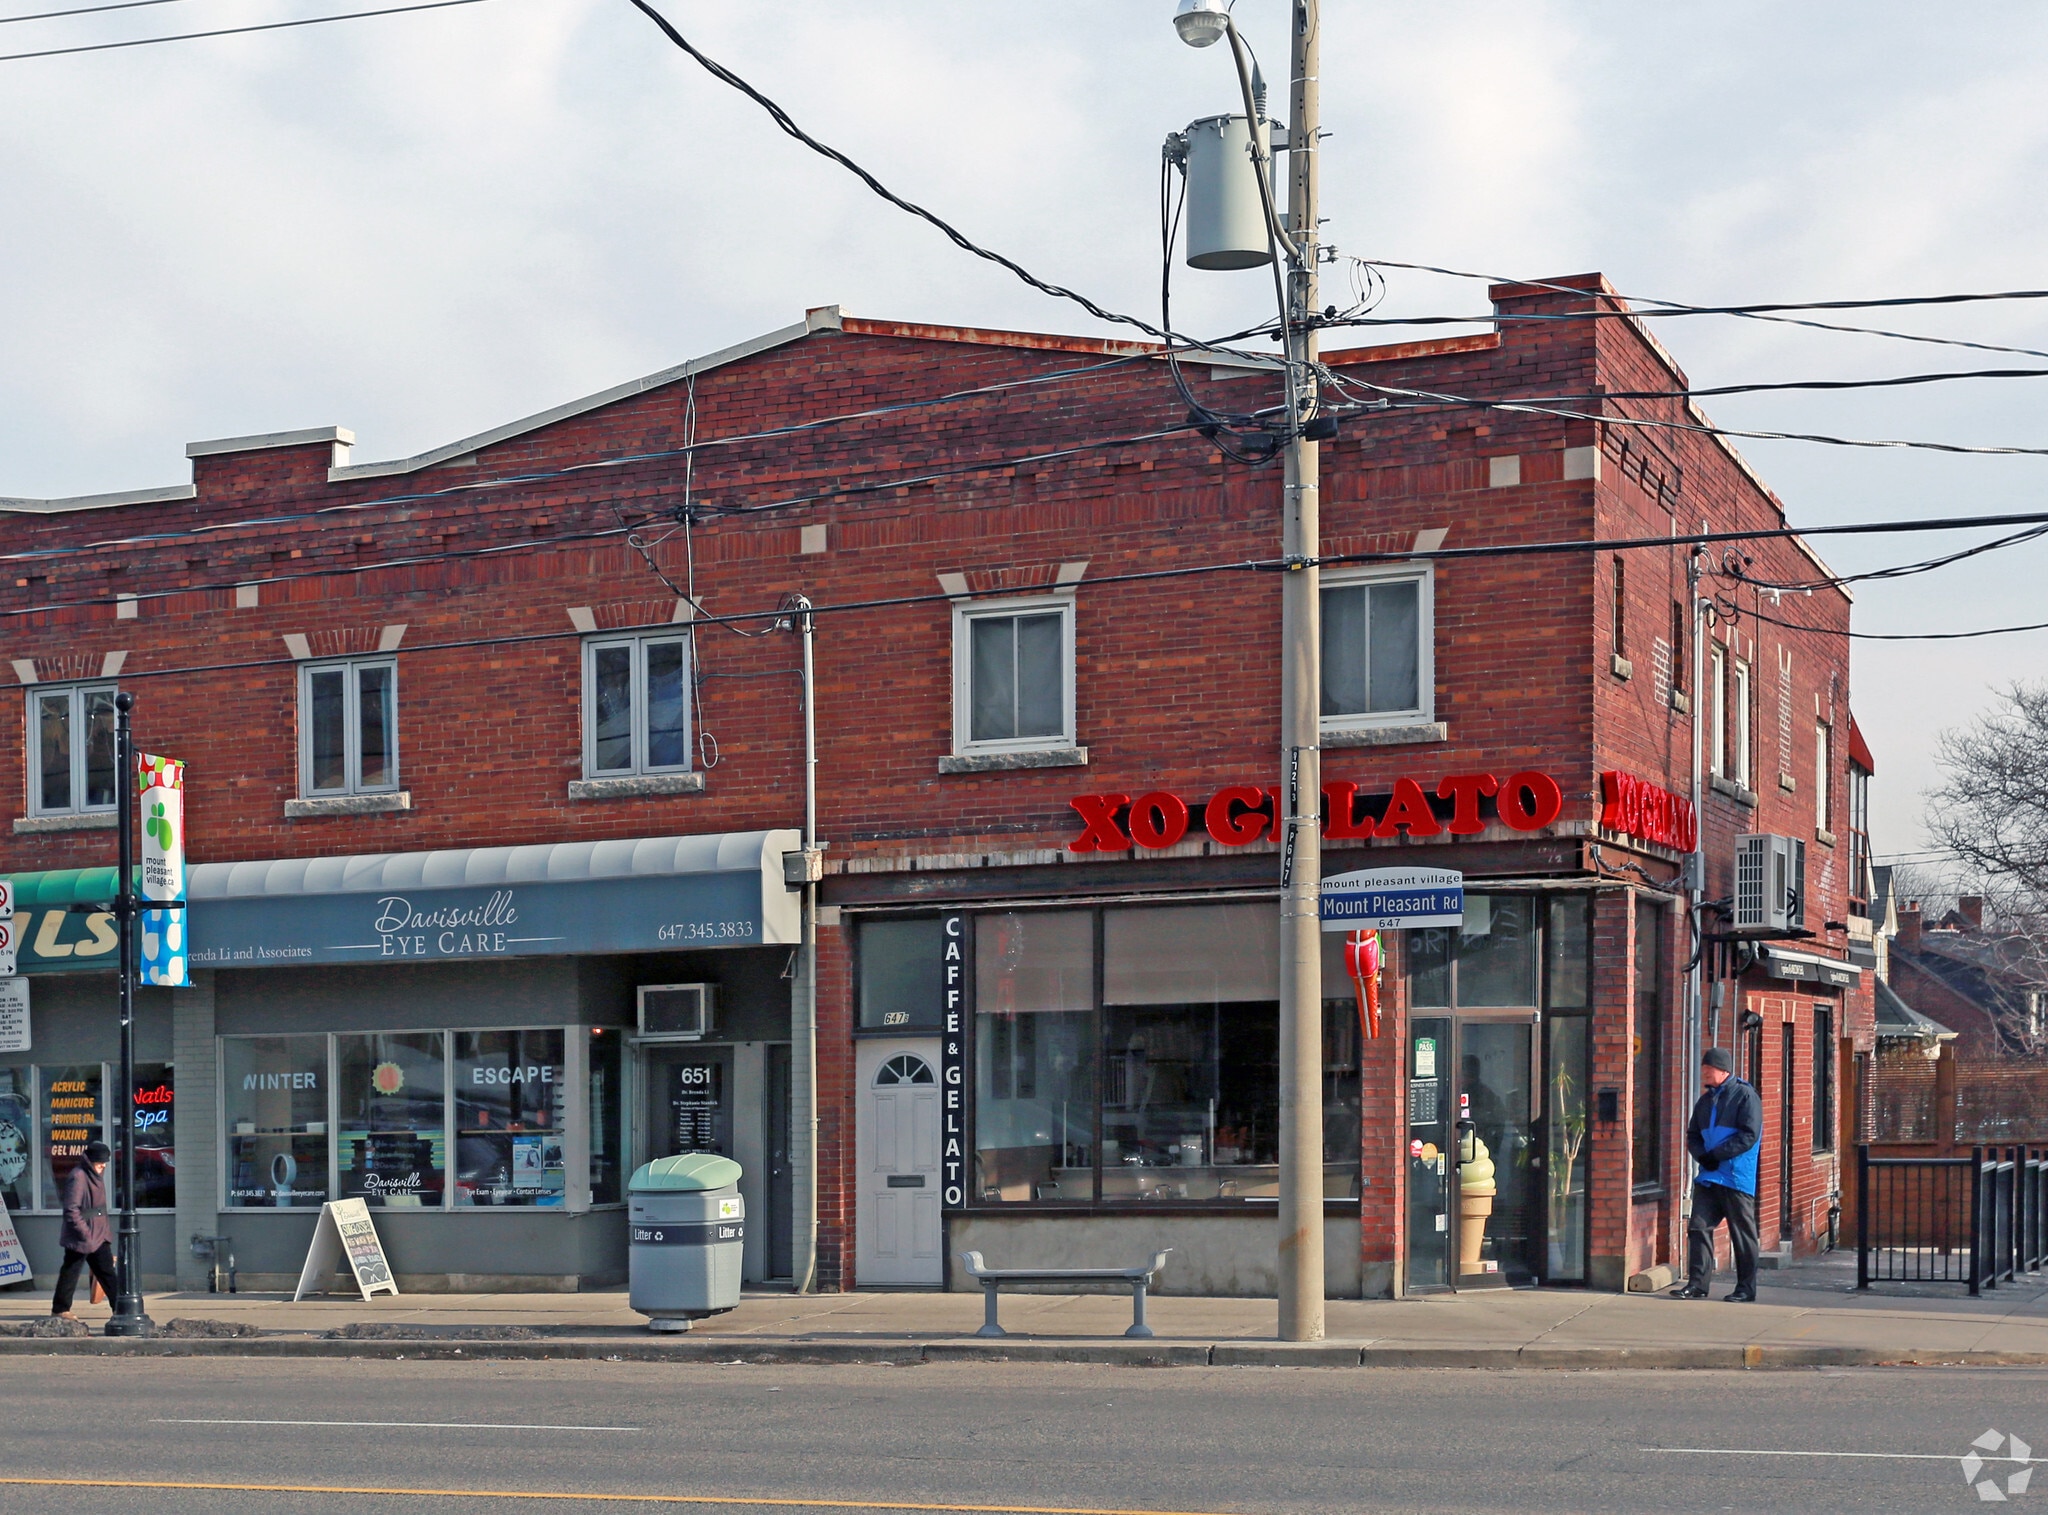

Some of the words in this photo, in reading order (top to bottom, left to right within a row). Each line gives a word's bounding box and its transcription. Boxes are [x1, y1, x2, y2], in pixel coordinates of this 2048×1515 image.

[1068, 791, 1189, 853] XO
[146, 857, 167, 866] mount
[1283, 831, 1295, 880] P647
[146, 865, 173, 876] pleasant
[146, 875, 174, 887] village.ca
[1323, 879, 1360, 889] mount
[1364, 876, 1416, 888] pleasant
[1420, 874, 1460, 885] village
[375, 890, 519, 934] Davisville
[1323, 897, 1369, 915] Mount
[1373, 894, 1436, 913] Pleasant
[1443, 896, 1458, 910] Rd
[658, 921, 753, 941] 647.345.3833
[1379, 919, 1401, 928] 647
[12, 910, 118, 957] ILS
[380, 934, 426, 956] EYE
[438, 931, 507, 954] CARE
[187, 949, 216, 962] renda
[219, 949, 231, 961] Li
[233, 948, 253, 960] and
[256, 946, 312, 959] Associates
[1418, 1043, 1433, 1051] PASS
[243, 1072, 316, 1090] WINTER
[473, 1066, 553, 1084] ESCAPE
[681, 1068, 711, 1084] 651
[51, 1081, 86, 1092] ACRYLIC
[51, 1097, 95, 1108] MANICURE
[51, 1114, 82, 1124] PEDICURE
[82, 1113, 95, 1124] SPA
[134, 1109, 168, 1132] Spa
[51, 1129, 88, 1141] WAXING
[945, 1066, 961, 1205] GELATO
[51, 1145, 68, 1156] GEL
[364, 1172, 421, 1188] Davisville
[371, 1188, 387, 1196] EYE
[390, 1187, 412, 1195] CARE
[634, 1228, 652, 1241] Litter
[719, 1226, 736, 1239] Litter
